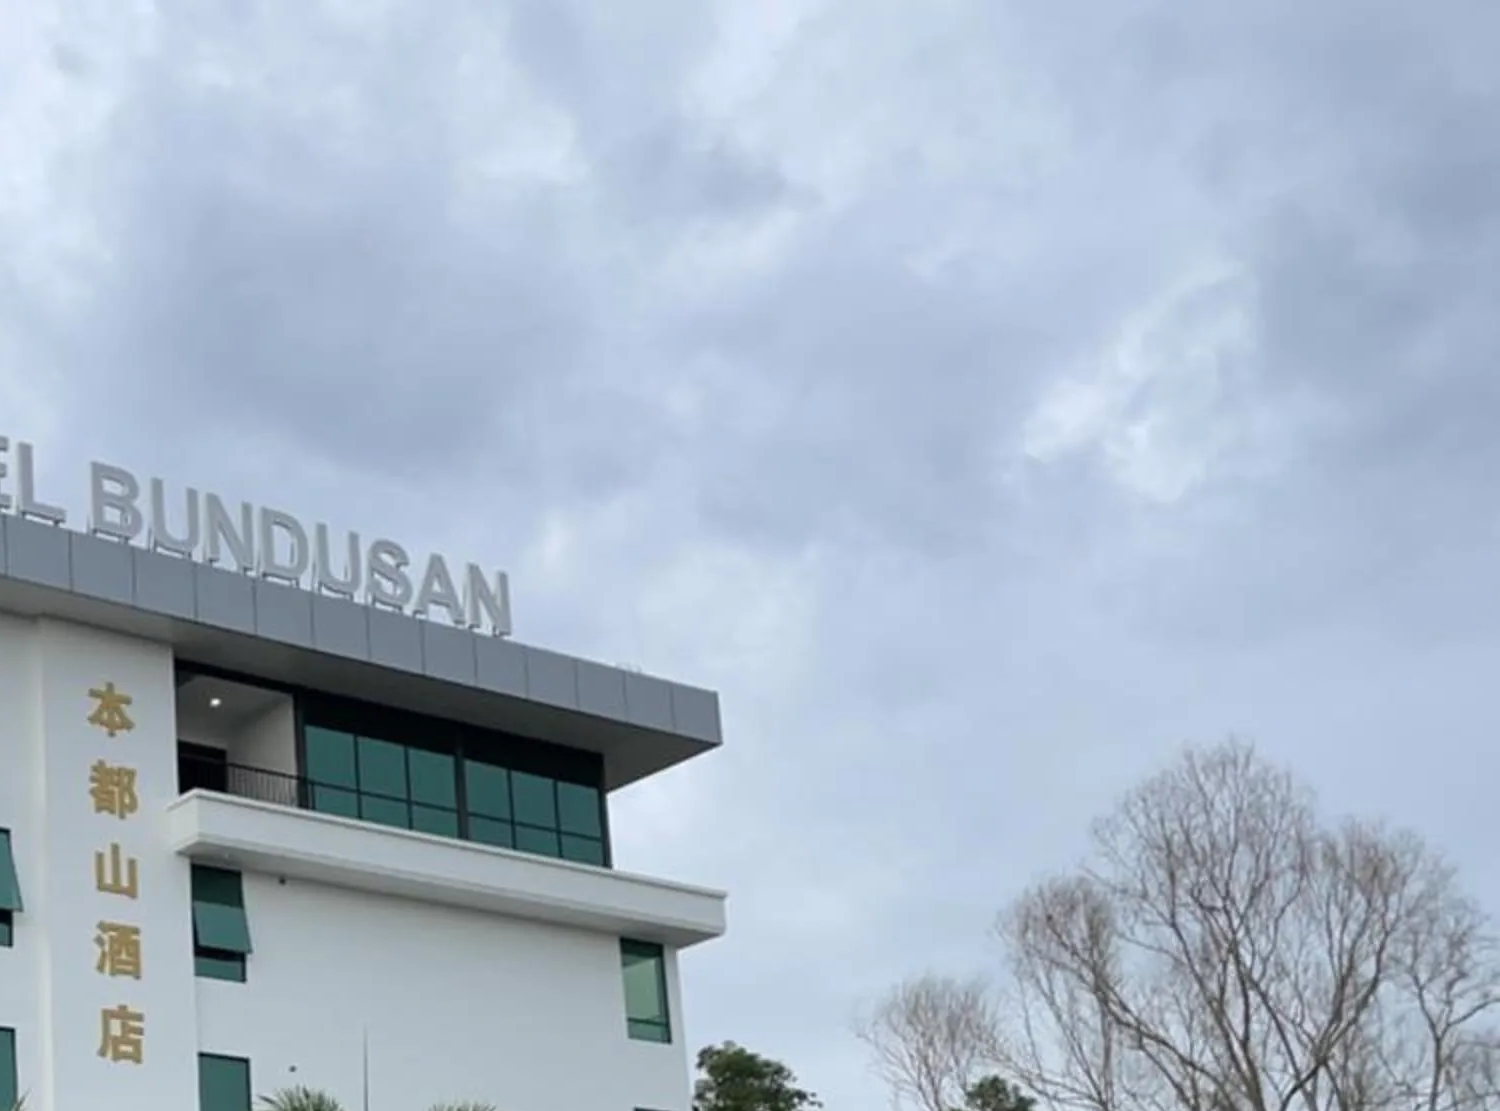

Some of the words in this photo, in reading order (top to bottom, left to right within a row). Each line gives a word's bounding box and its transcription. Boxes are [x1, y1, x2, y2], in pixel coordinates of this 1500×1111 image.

[90, 461, 512, 637] BUNDUSAN
[87, 682, 145, 1064] 本都山酒店
